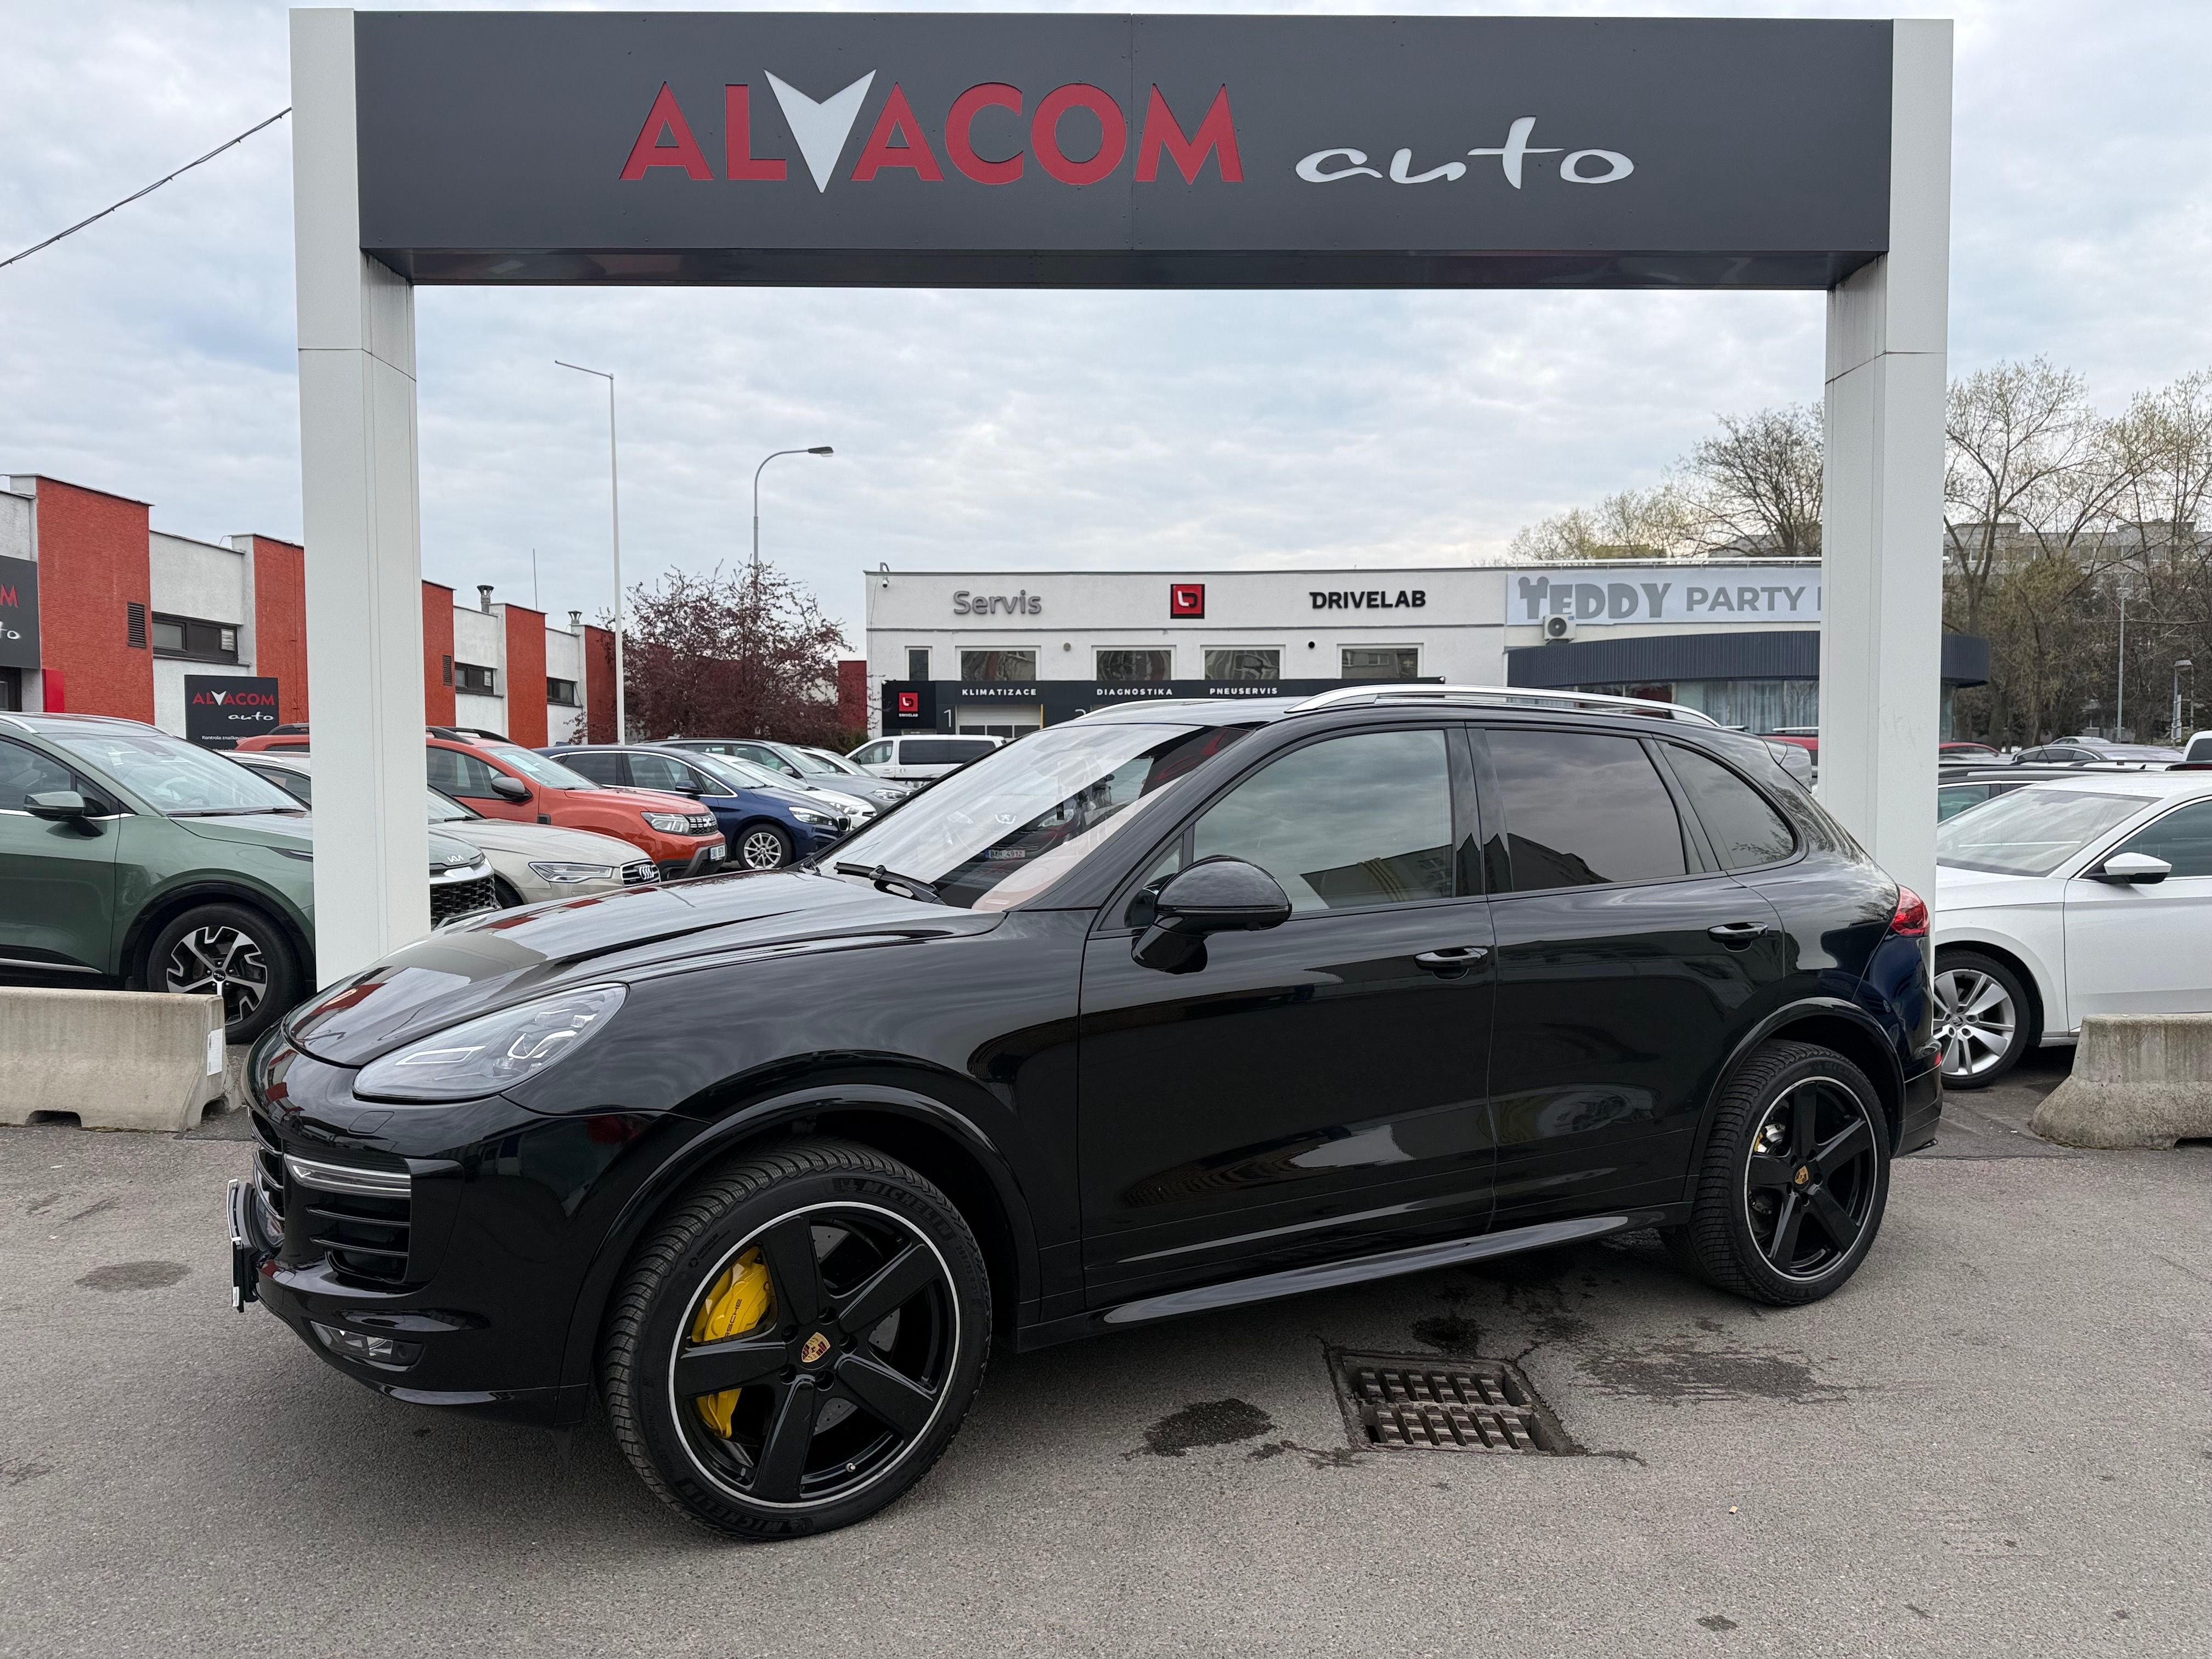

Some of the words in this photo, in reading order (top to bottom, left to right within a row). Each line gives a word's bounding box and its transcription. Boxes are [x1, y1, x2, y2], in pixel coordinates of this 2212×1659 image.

[619, 69, 1244, 193] ALVACOM
[1295, 116, 1634, 189] auto
[953, 589, 1042, 614] Servis
[1309, 590, 1426, 609] DRIVELAB
[1518, 576, 1672, 619] TEDDY
[1686, 586, 1805, 612] PARTY
[193, 690, 275, 706] ALVACOM
[228, 711, 274, 721] auto
[944, 709, 951, 727] 1
[861, 1181, 954, 1240] MICHELIN
[725, 1298, 742, 1337] RSCHE
[684, 1482, 785, 1533] MICHELIN
